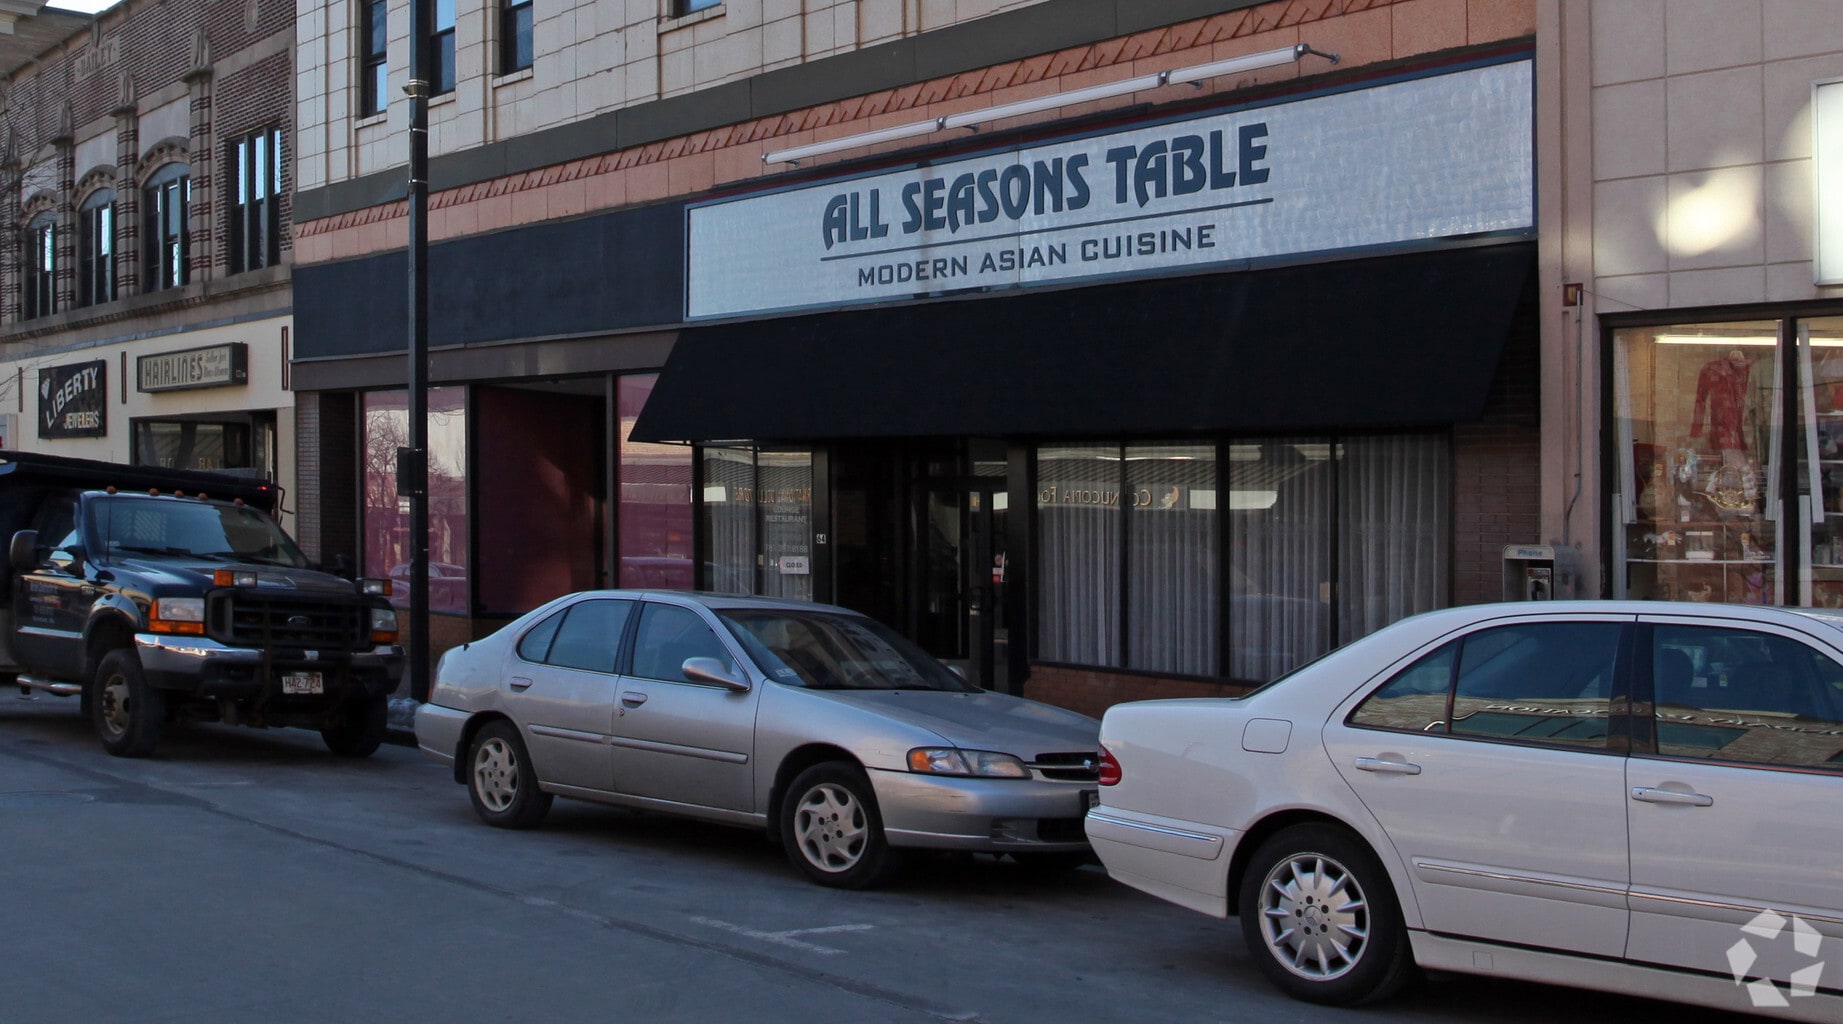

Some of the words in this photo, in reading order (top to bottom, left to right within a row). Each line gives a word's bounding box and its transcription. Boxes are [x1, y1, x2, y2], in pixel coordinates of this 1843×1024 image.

[822, 188, 889, 250] ALL
[901, 152, 1090, 234] SEASONS
[1106, 122, 1271, 208] TABLE
[858, 255, 968, 287] MODERN
[980, 242, 1067, 272] ASIAN
[1080, 224, 1216, 262] CUISINE
[144, 353, 203, 387] HAIRLINES
[45, 366, 99, 429] LIBERTY
[63, 410, 100, 430] JEWELERS
[765, 515, 807, 524] RESTAURANT
[1517, 549, 1543, 557] Phone
